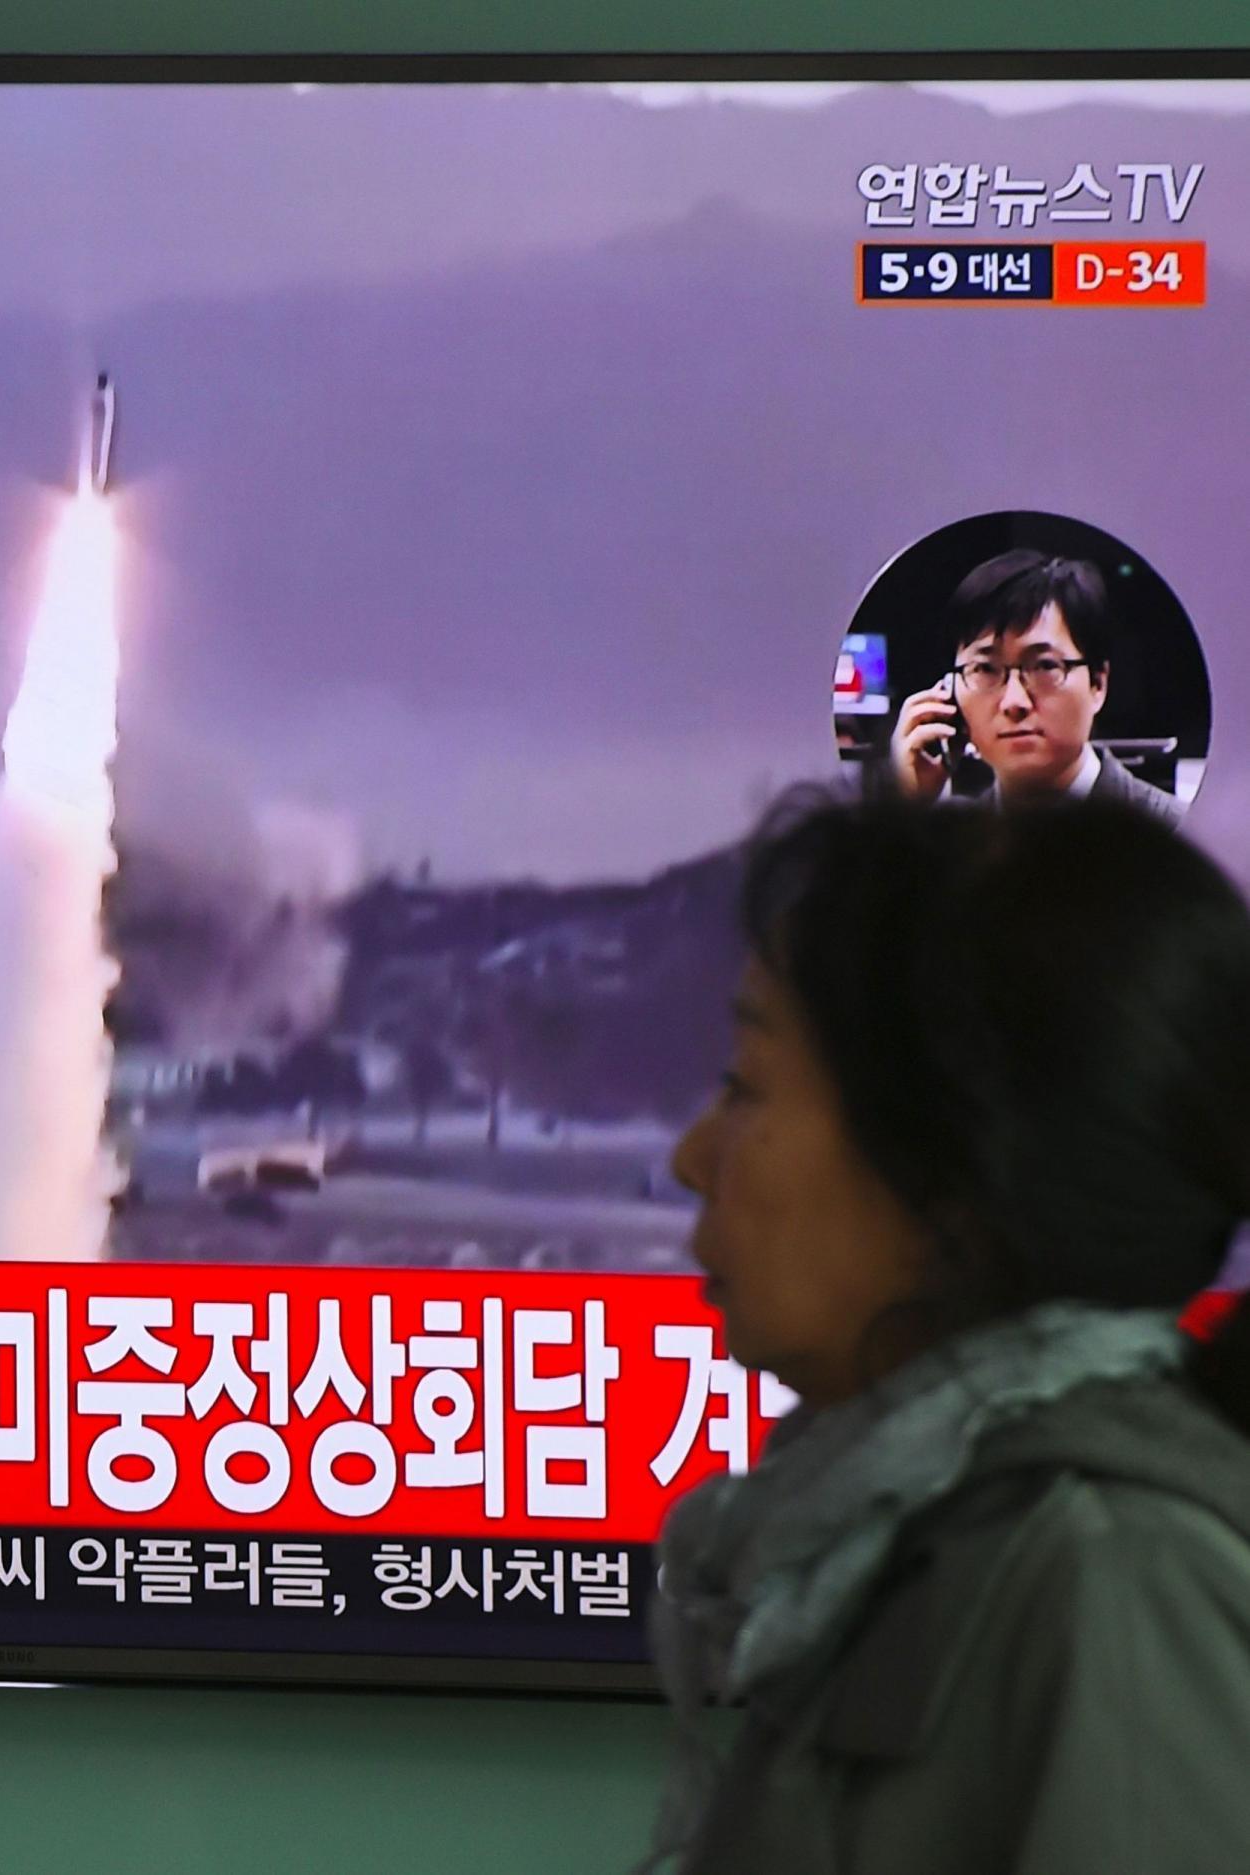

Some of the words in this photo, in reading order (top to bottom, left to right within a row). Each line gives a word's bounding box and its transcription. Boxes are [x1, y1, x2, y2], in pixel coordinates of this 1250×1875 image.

[857, 162, 1203, 226] 연합뉴스TV
[968, 252, 1031, 292] 대선
[1076, 251, 1182, 292] D-34
[649, 1325, 802, 1486] 겨
[68, 1538, 346, 1617] 악플러들,
[372, 1543, 631, 1618] 형사처벌
